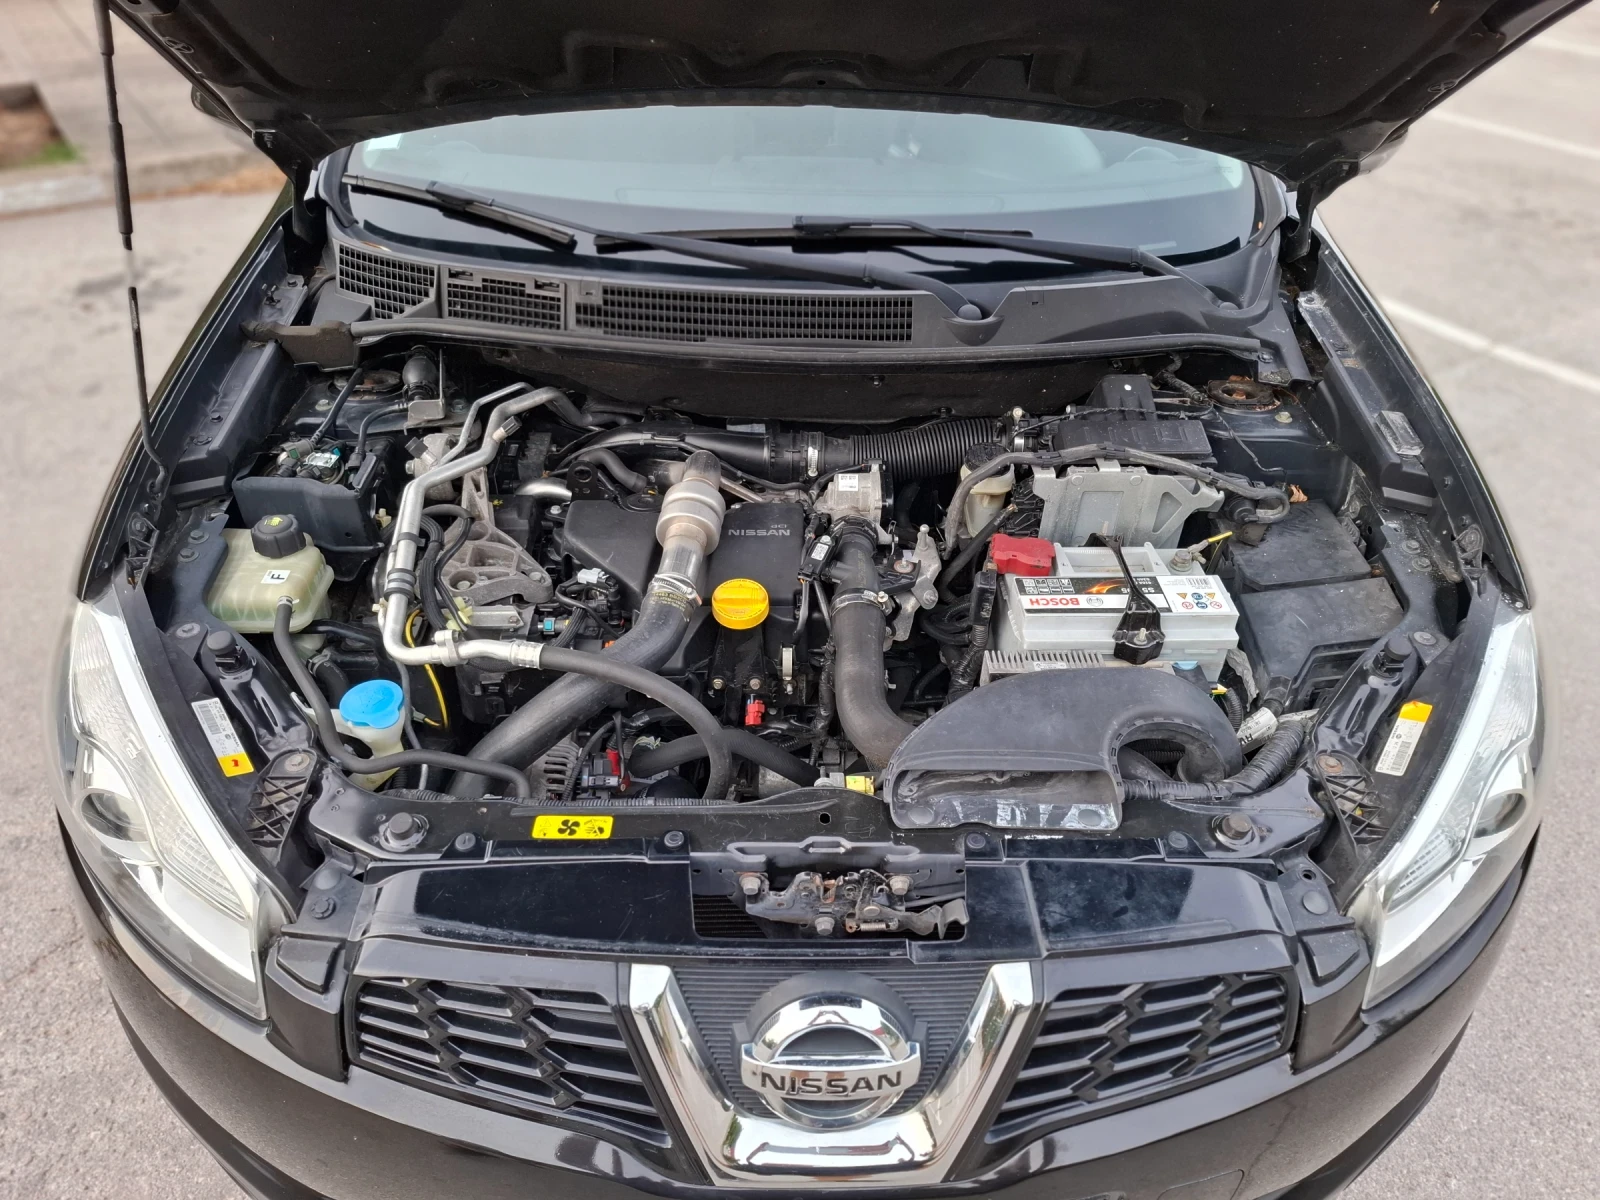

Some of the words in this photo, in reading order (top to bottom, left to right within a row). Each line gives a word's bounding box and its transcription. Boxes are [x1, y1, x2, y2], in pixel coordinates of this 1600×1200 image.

[271, 573, 285, 581] F
[1029, 597, 1080, 606] BOSCH
[760, 1070, 902, 1096] NISSAN
